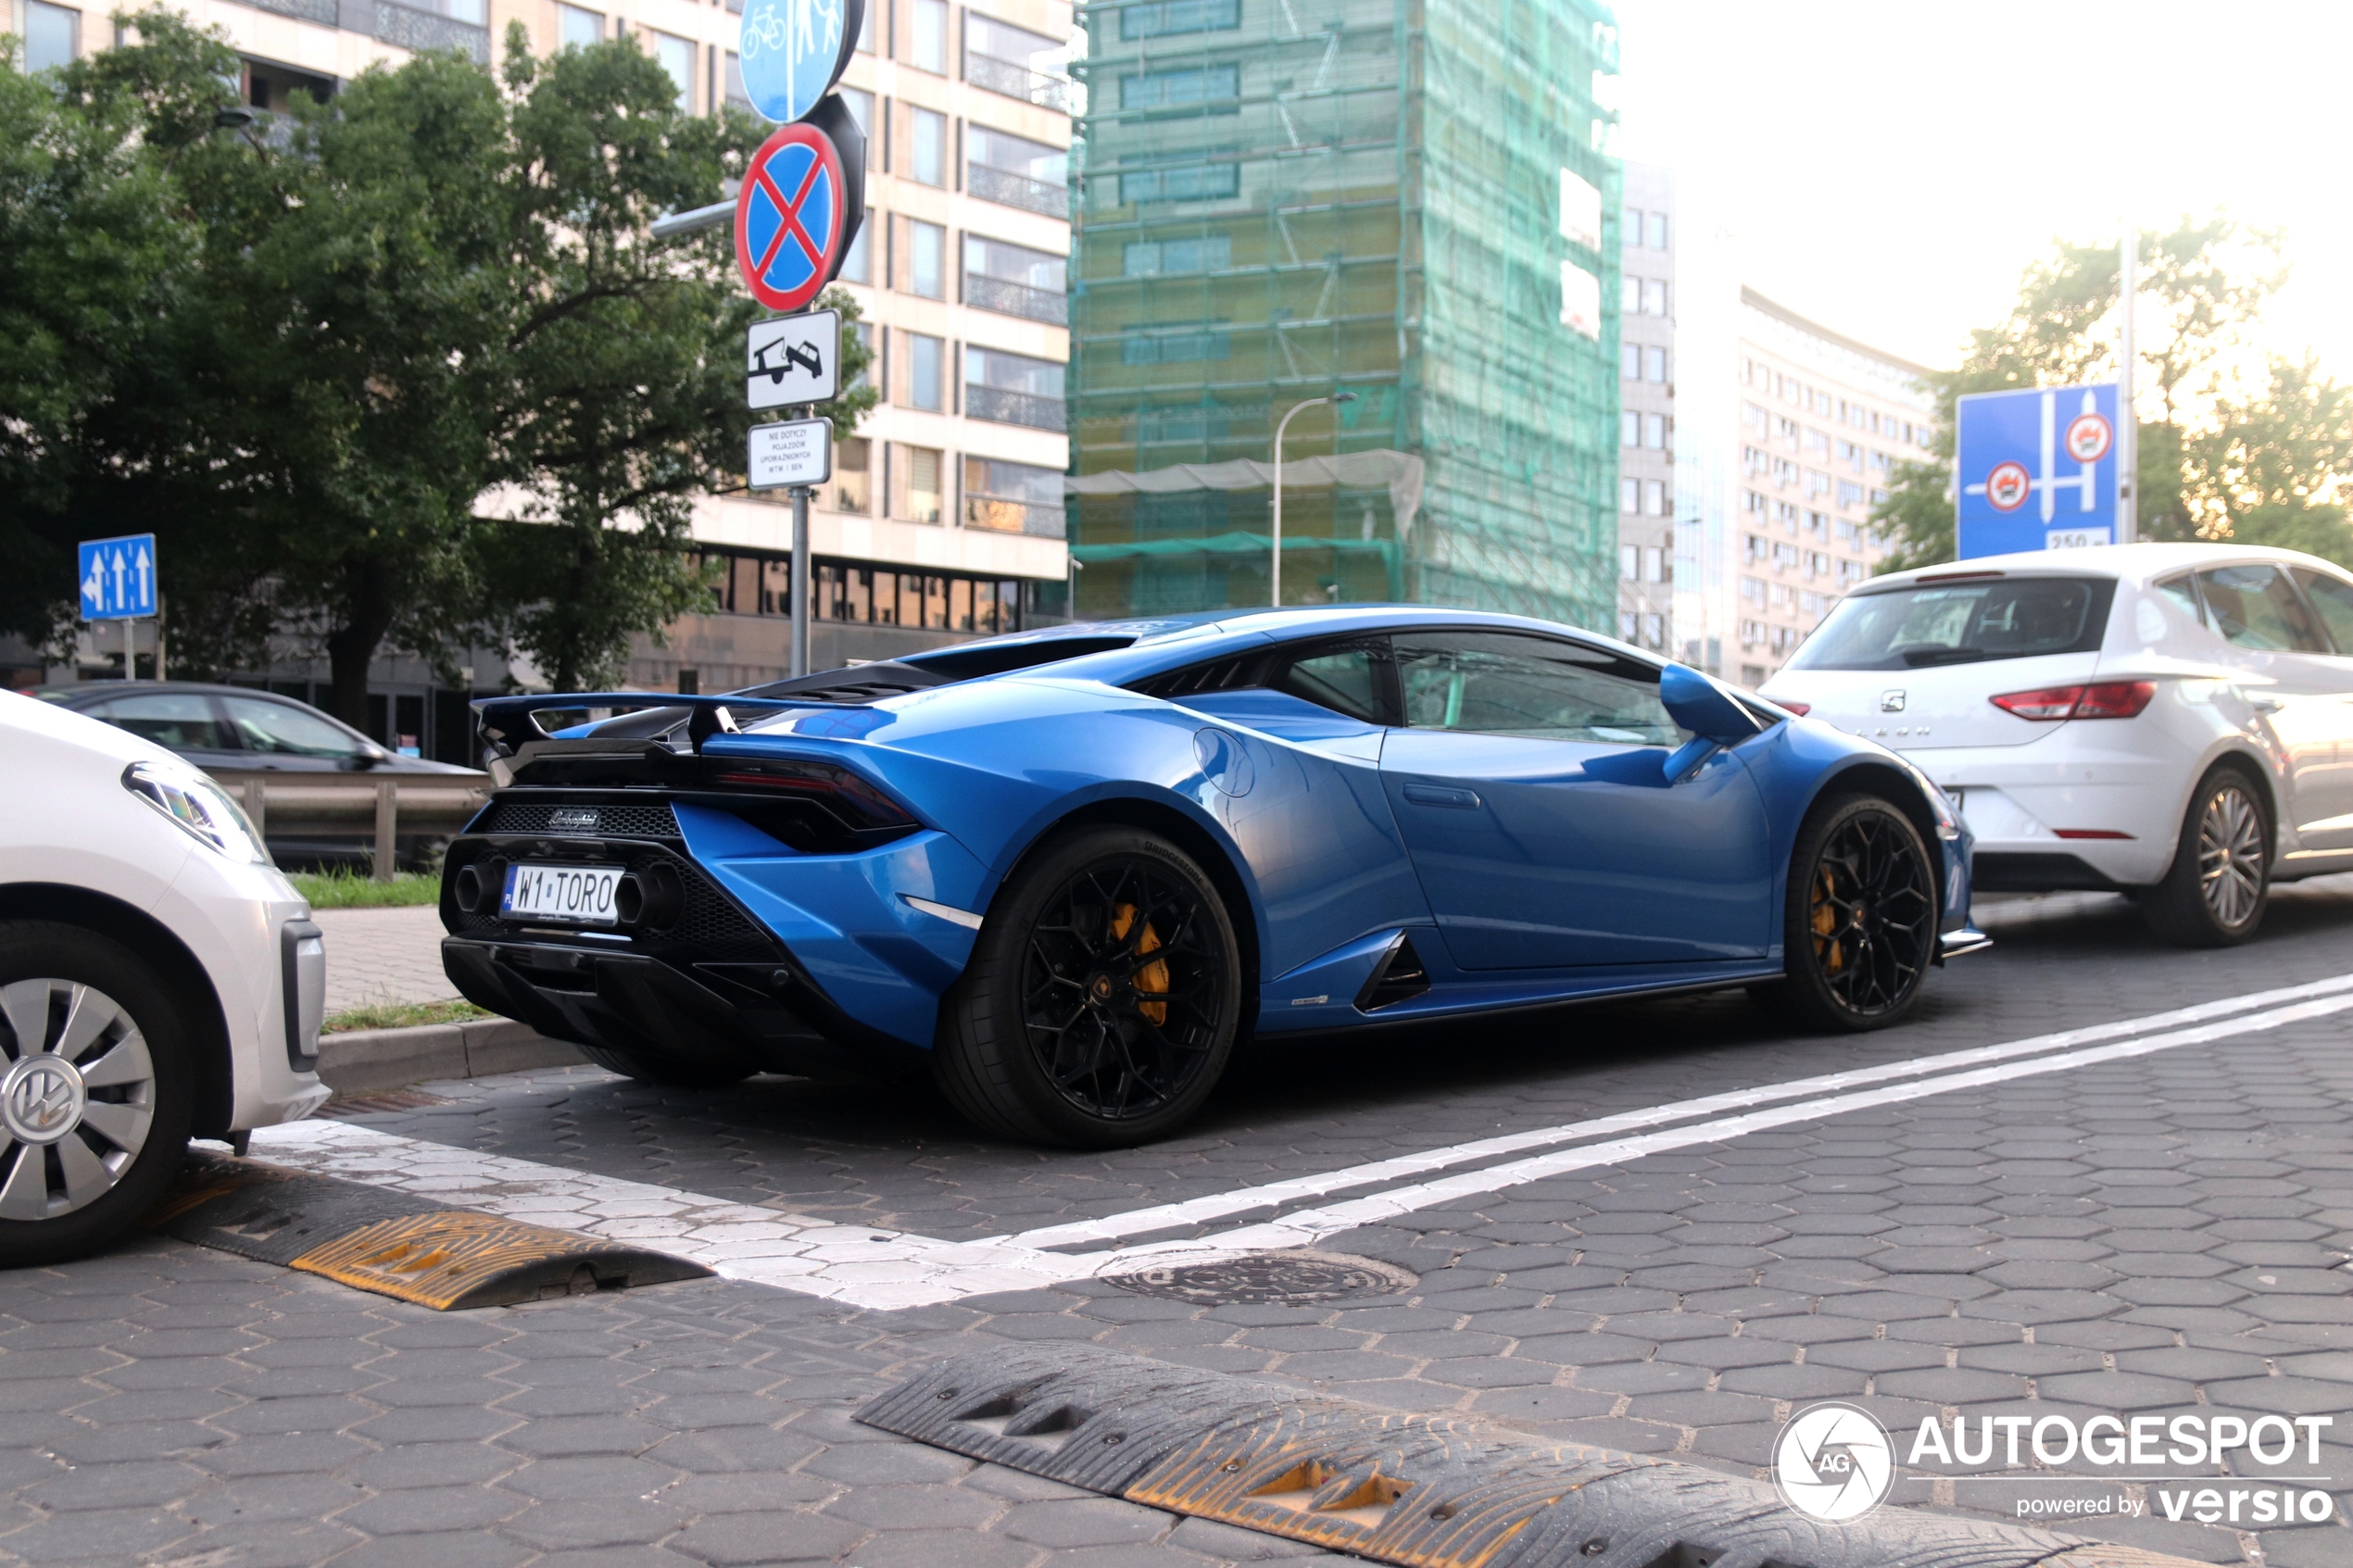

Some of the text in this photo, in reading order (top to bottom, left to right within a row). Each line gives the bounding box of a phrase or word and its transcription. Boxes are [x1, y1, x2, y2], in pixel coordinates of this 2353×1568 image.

[769, 429, 807, 441] NIE DOTYCZY
[772, 440, 806, 451] POJAZDÓW
[2051, 533, 2087, 550] 250
[1144, 841, 1204, 886] BRIDGESTONE
[504, 893, 512, 904] PL
[518, 871, 613, 912] W1 TORO
